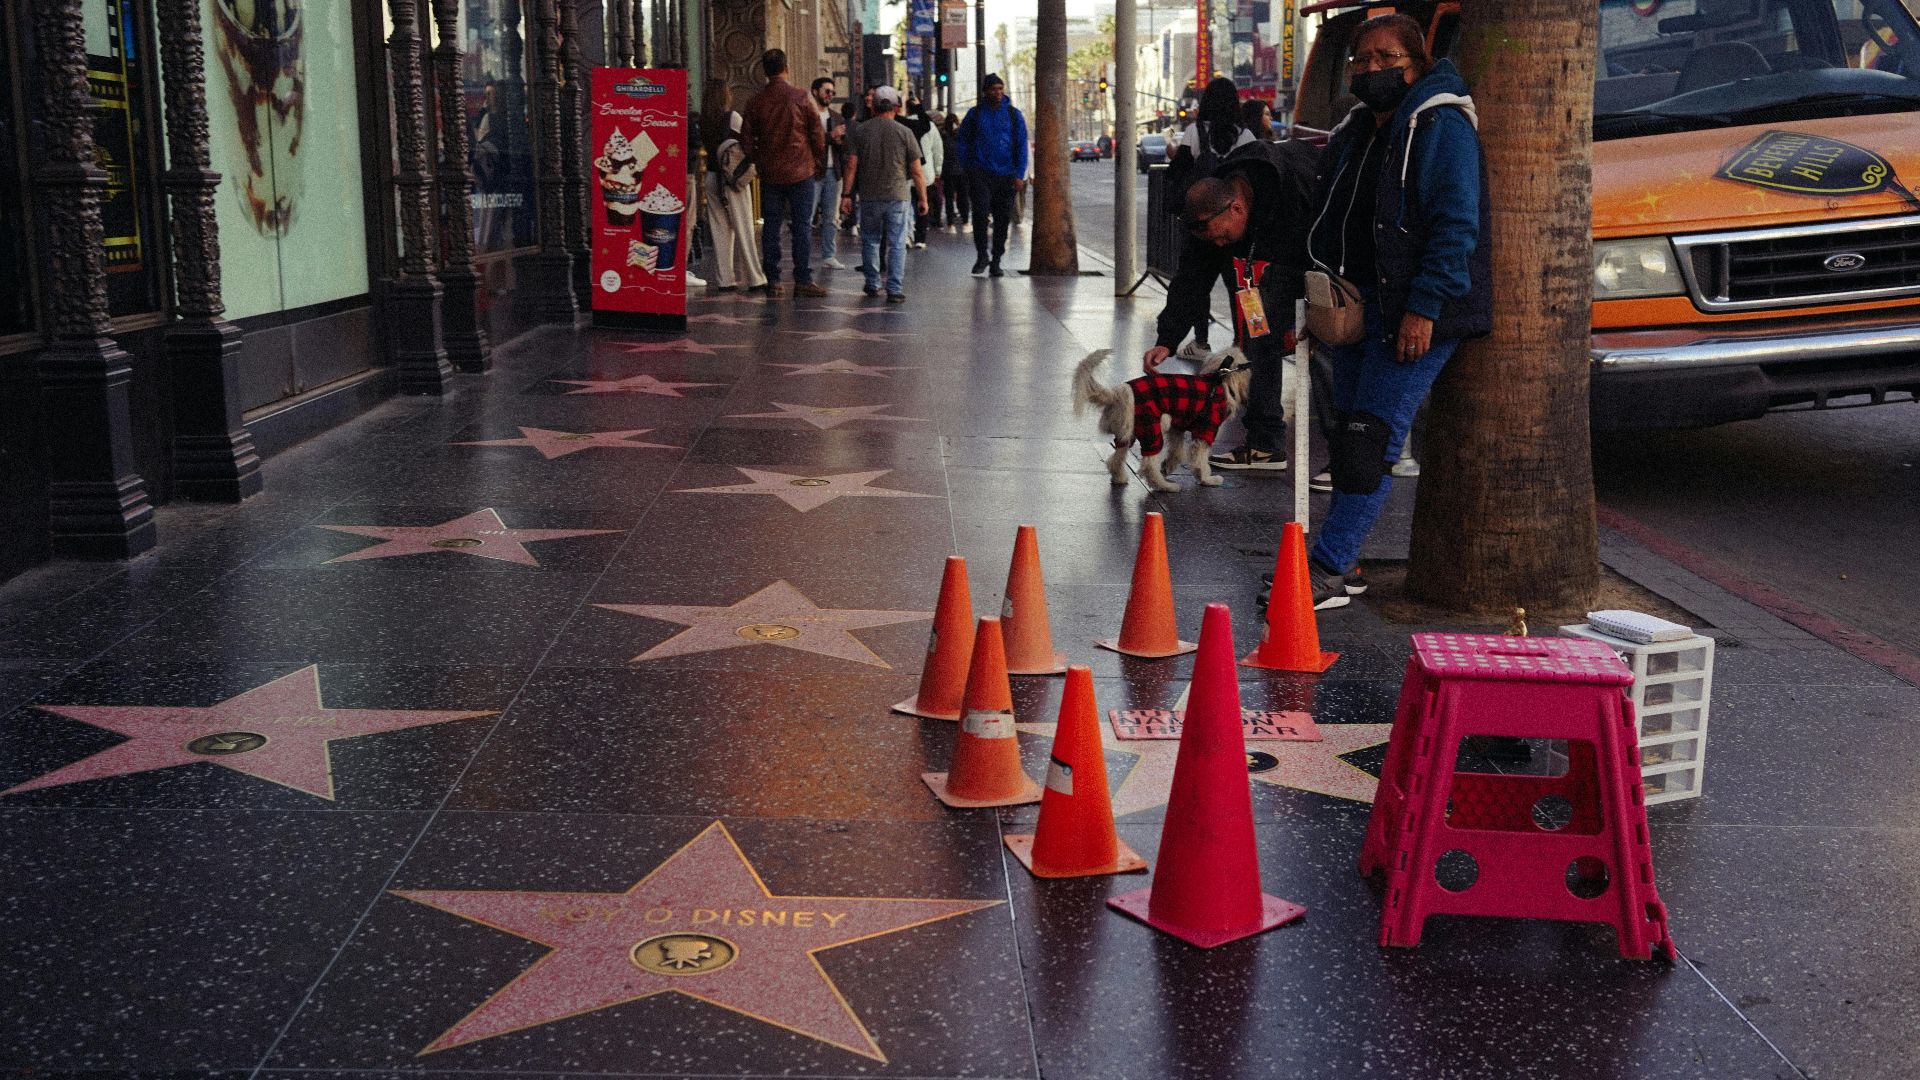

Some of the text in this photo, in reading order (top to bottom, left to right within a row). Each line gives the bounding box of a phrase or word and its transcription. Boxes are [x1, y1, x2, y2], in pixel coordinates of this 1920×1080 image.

[615, 85, 664, 93] GHIRARDELLI
[600, 102, 643, 116] Sweeten
[641, 114, 679, 128] Season
[1790, 145, 1844, 181] HILLS
[1833, 256, 1856, 268] Ford
[1119, 717, 1185, 725] NAM
[690, 908, 848, 929] DISNEY
